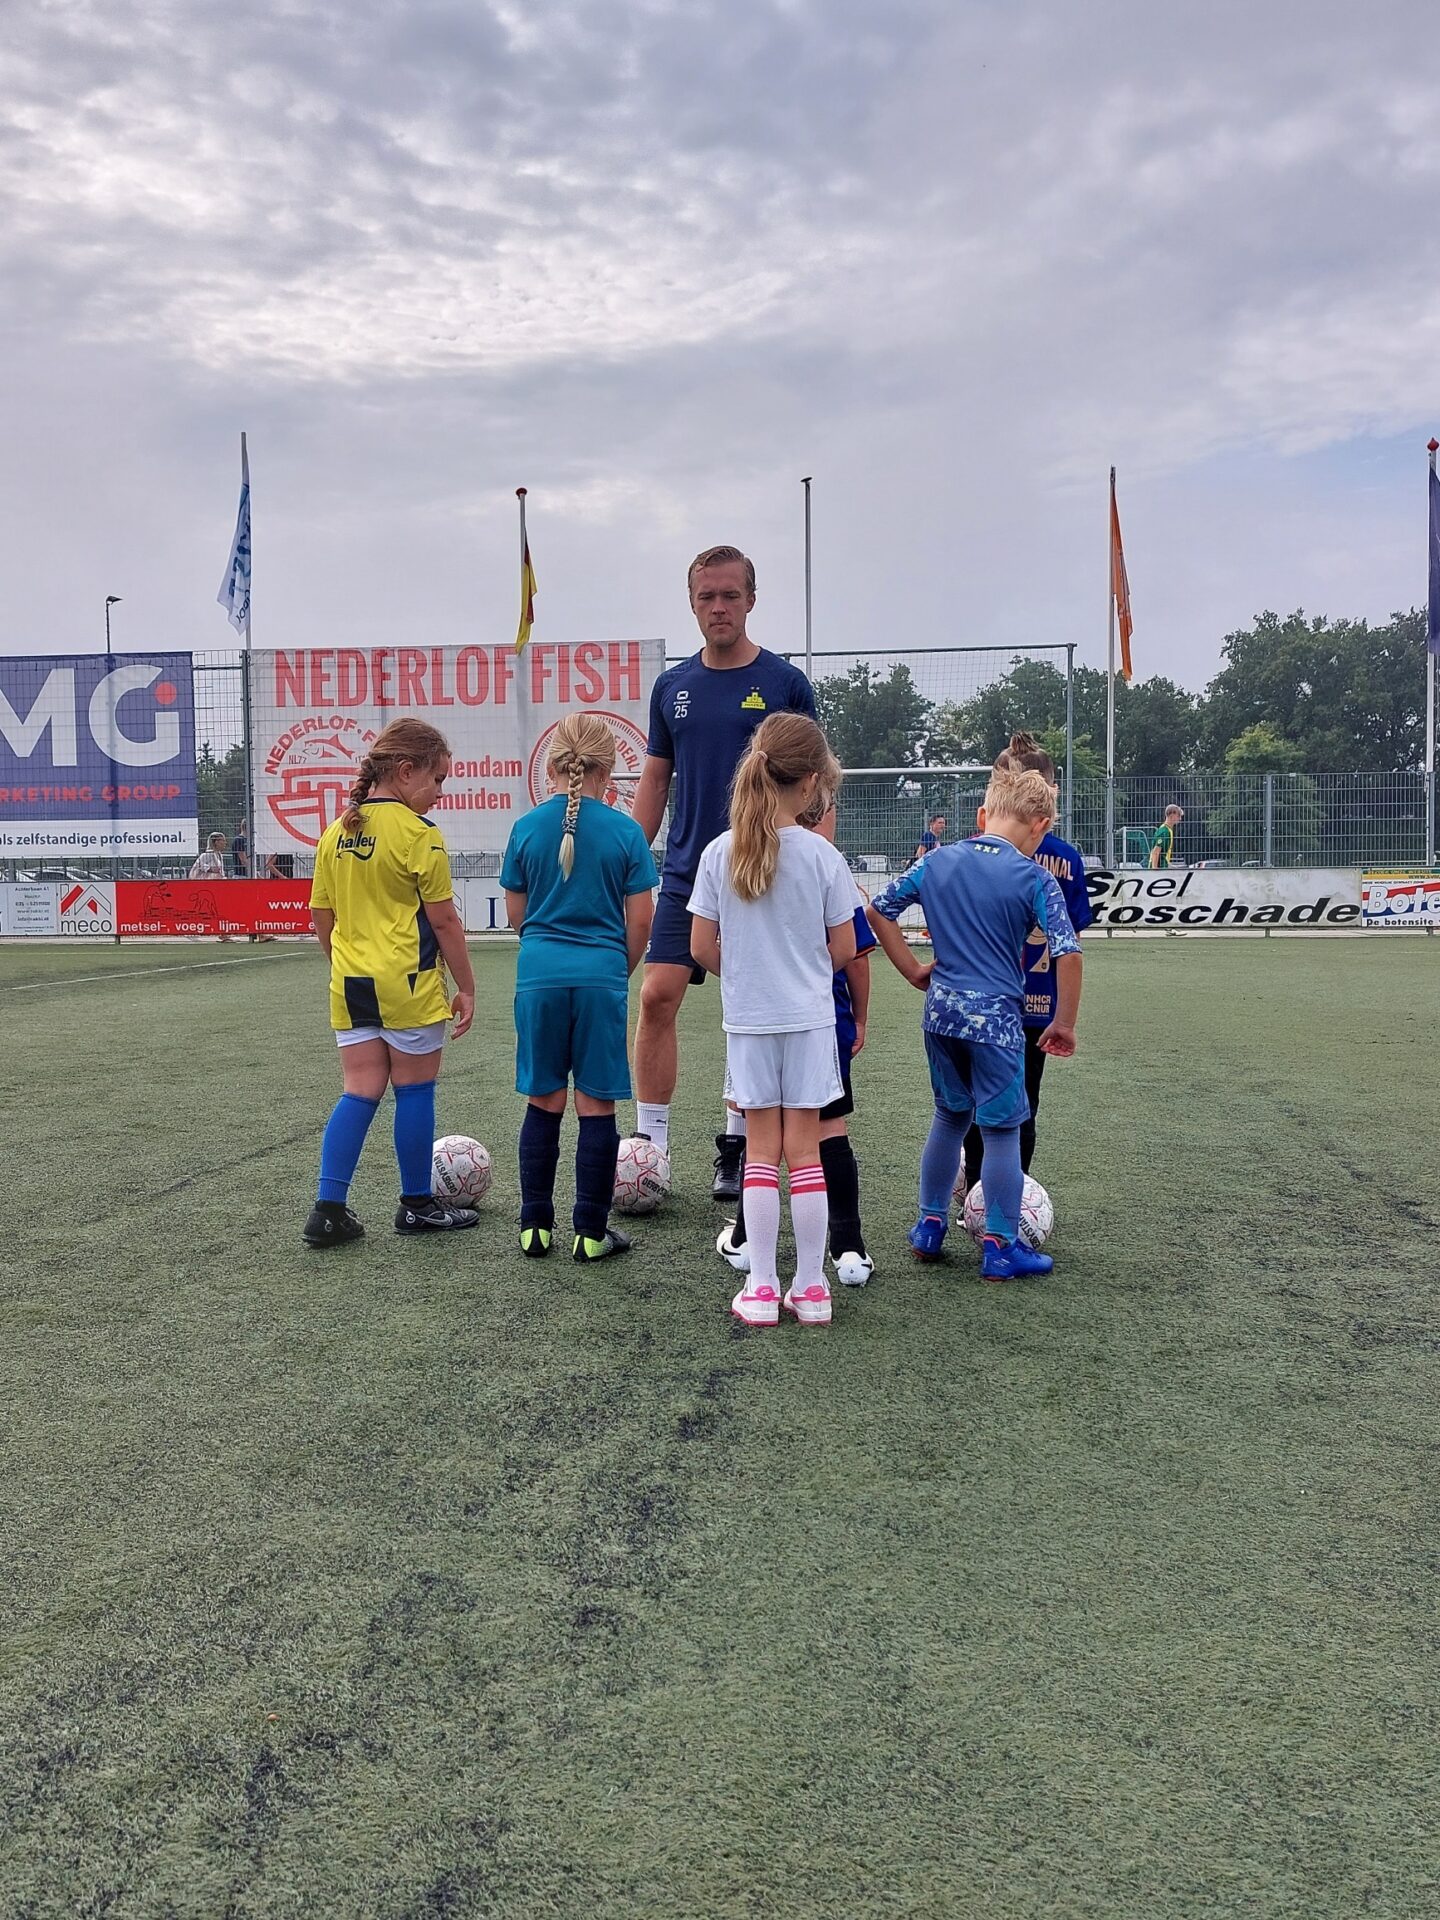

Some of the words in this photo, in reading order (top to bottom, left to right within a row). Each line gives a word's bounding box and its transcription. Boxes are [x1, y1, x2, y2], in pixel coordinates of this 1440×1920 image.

[274, 645, 514, 708] NEDERLOF
[531, 641, 641, 704] FISH
[674, 704, 688, 718] 25
[264, 714, 358, 776] NEDERLOF
[102, 784, 181, 801] GROUP
[430, 787, 511, 810] muiden
[16, 832, 97, 848] zelfstandige
[100, 831, 186, 848] professional.
[336, 831, 377, 861] halley
[1034, 853, 1074, 881] YAMAL
[1084, 871, 1194, 898] Snel
[61, 920, 112, 933] meco
[255, 919, 303, 931] timmer-
[1384, 917, 1434, 926] botensite
[433, 1154, 458, 1194] DERBYSTAR
